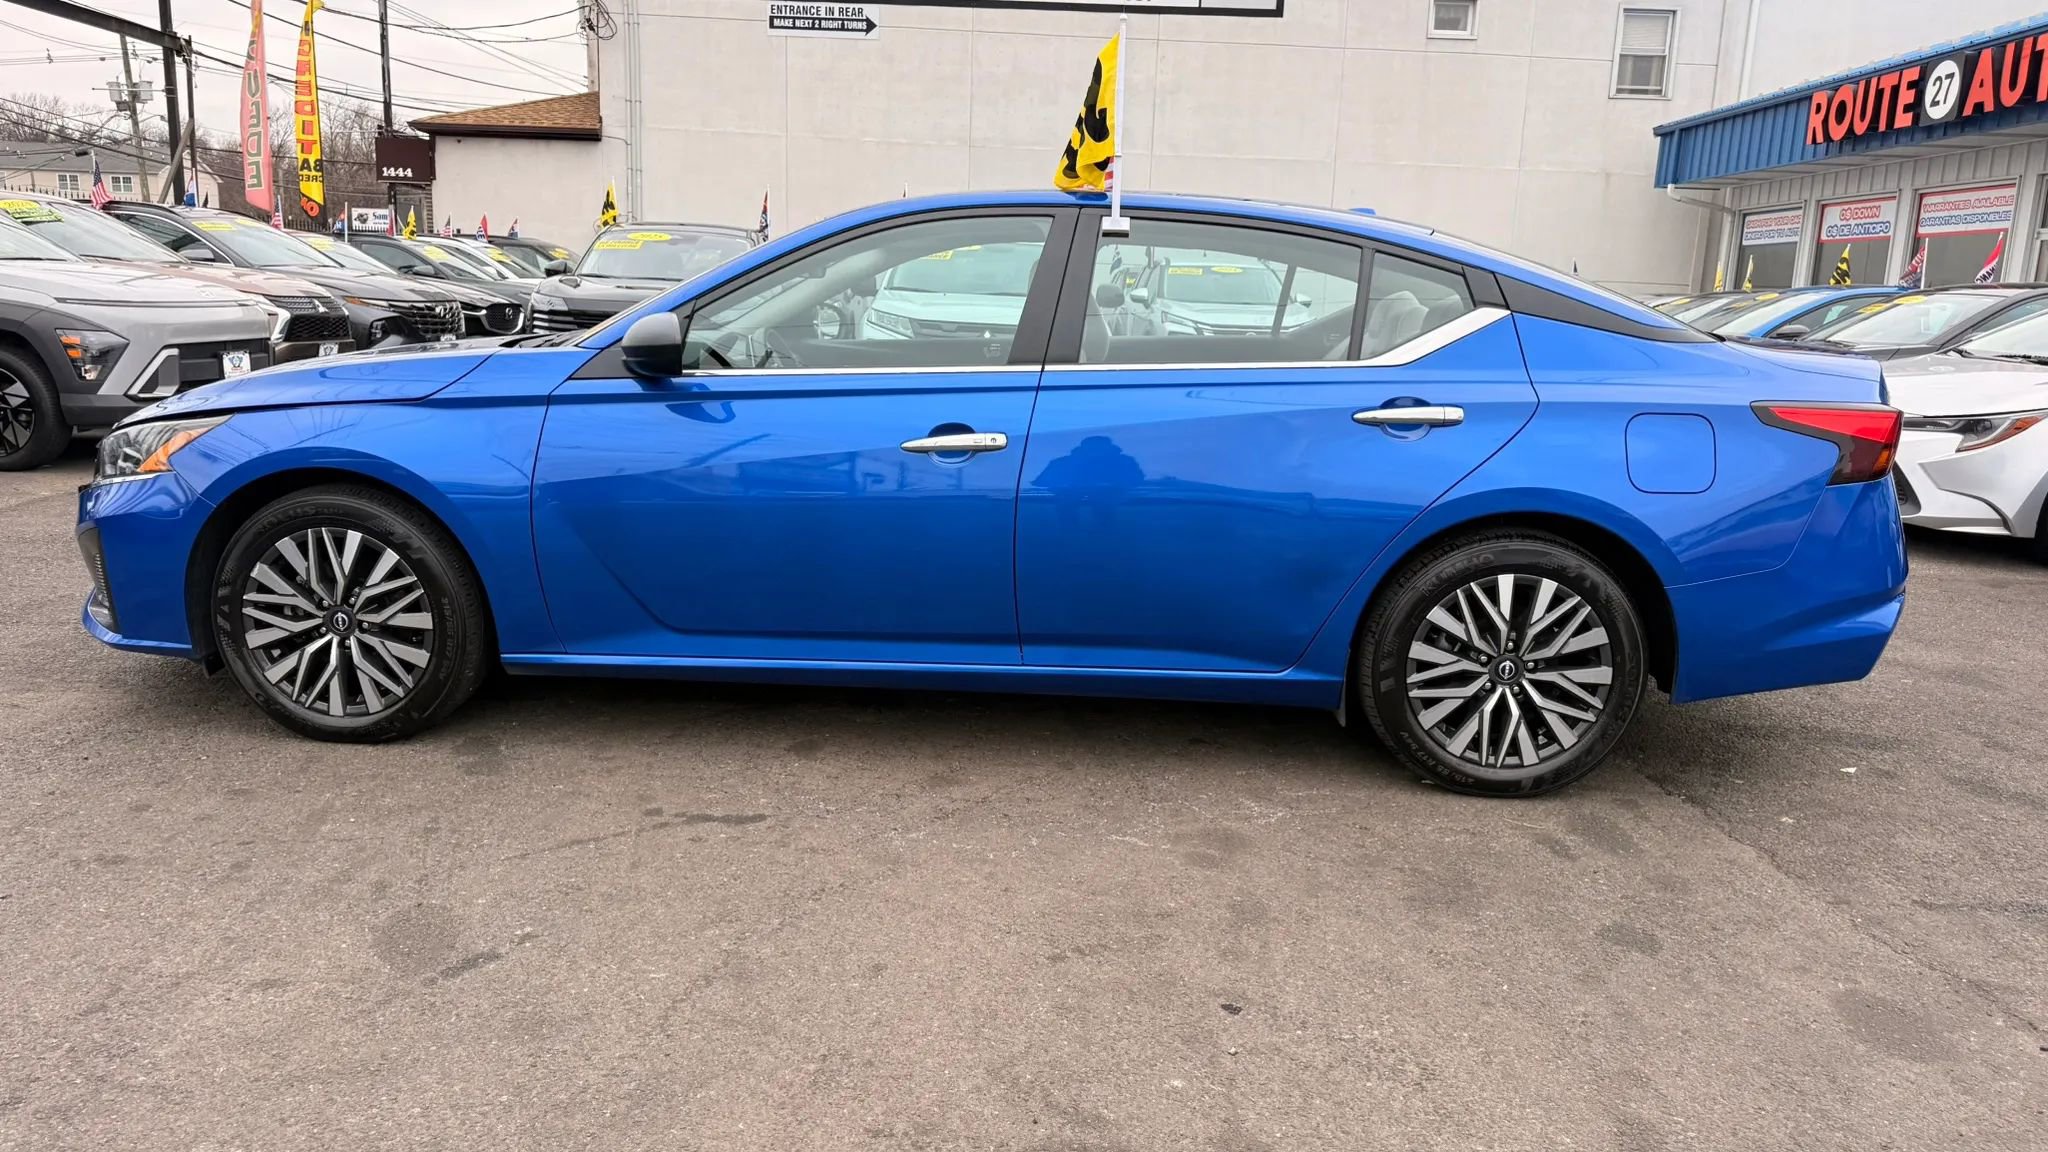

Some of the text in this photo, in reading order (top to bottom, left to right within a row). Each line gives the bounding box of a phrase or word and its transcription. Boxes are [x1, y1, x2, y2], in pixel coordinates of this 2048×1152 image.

[770, 4, 864, 17] ENTRANCE IN REAR
[773, 18, 867, 30] MAKE NEXT 2 RIGHT TURNS
[1806, 65, 1921, 145] ROUTE
[1929, 72, 1956, 108] 27
[382, 167, 413, 178] 1444
[1923, 195, 2015, 213] WARRANTIES AVAILABLE
[1852, 205, 1881, 219] DOWN
[1920, 210, 2013, 227] GARANTIAS DISPONIBLES
[1839, 223, 1851, 236] DE
[1851, 220, 1891, 235] ANTICIPO
